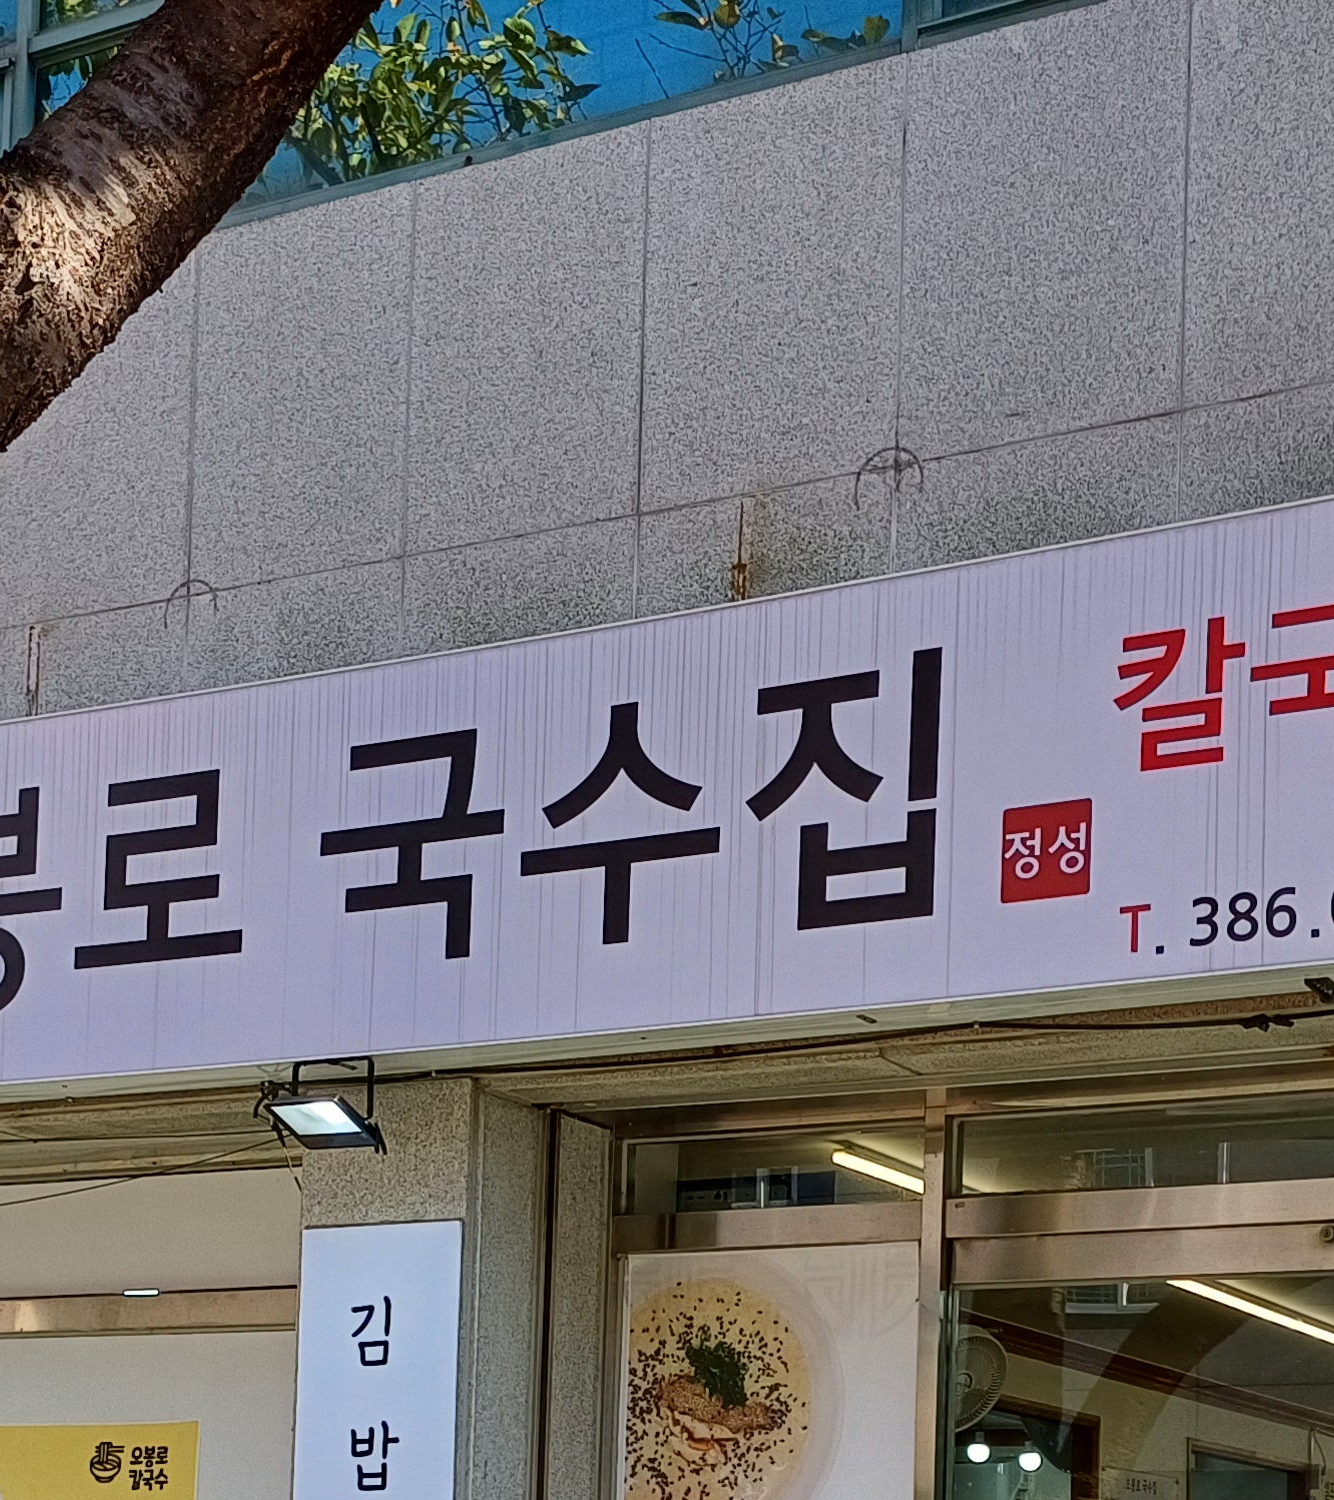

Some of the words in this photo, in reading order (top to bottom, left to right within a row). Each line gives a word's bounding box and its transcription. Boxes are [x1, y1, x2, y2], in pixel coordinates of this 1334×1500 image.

[319, 646, 944, 960] 국수집
[1003, 821, 1089, 880] 정성
[1119, 904, 1166, 955] T.
[349, 1294, 400, 1492] 김밥
[128, 1468, 169, 1491] 칼국수
[129, 1445, 169, 1468] 오봉로
